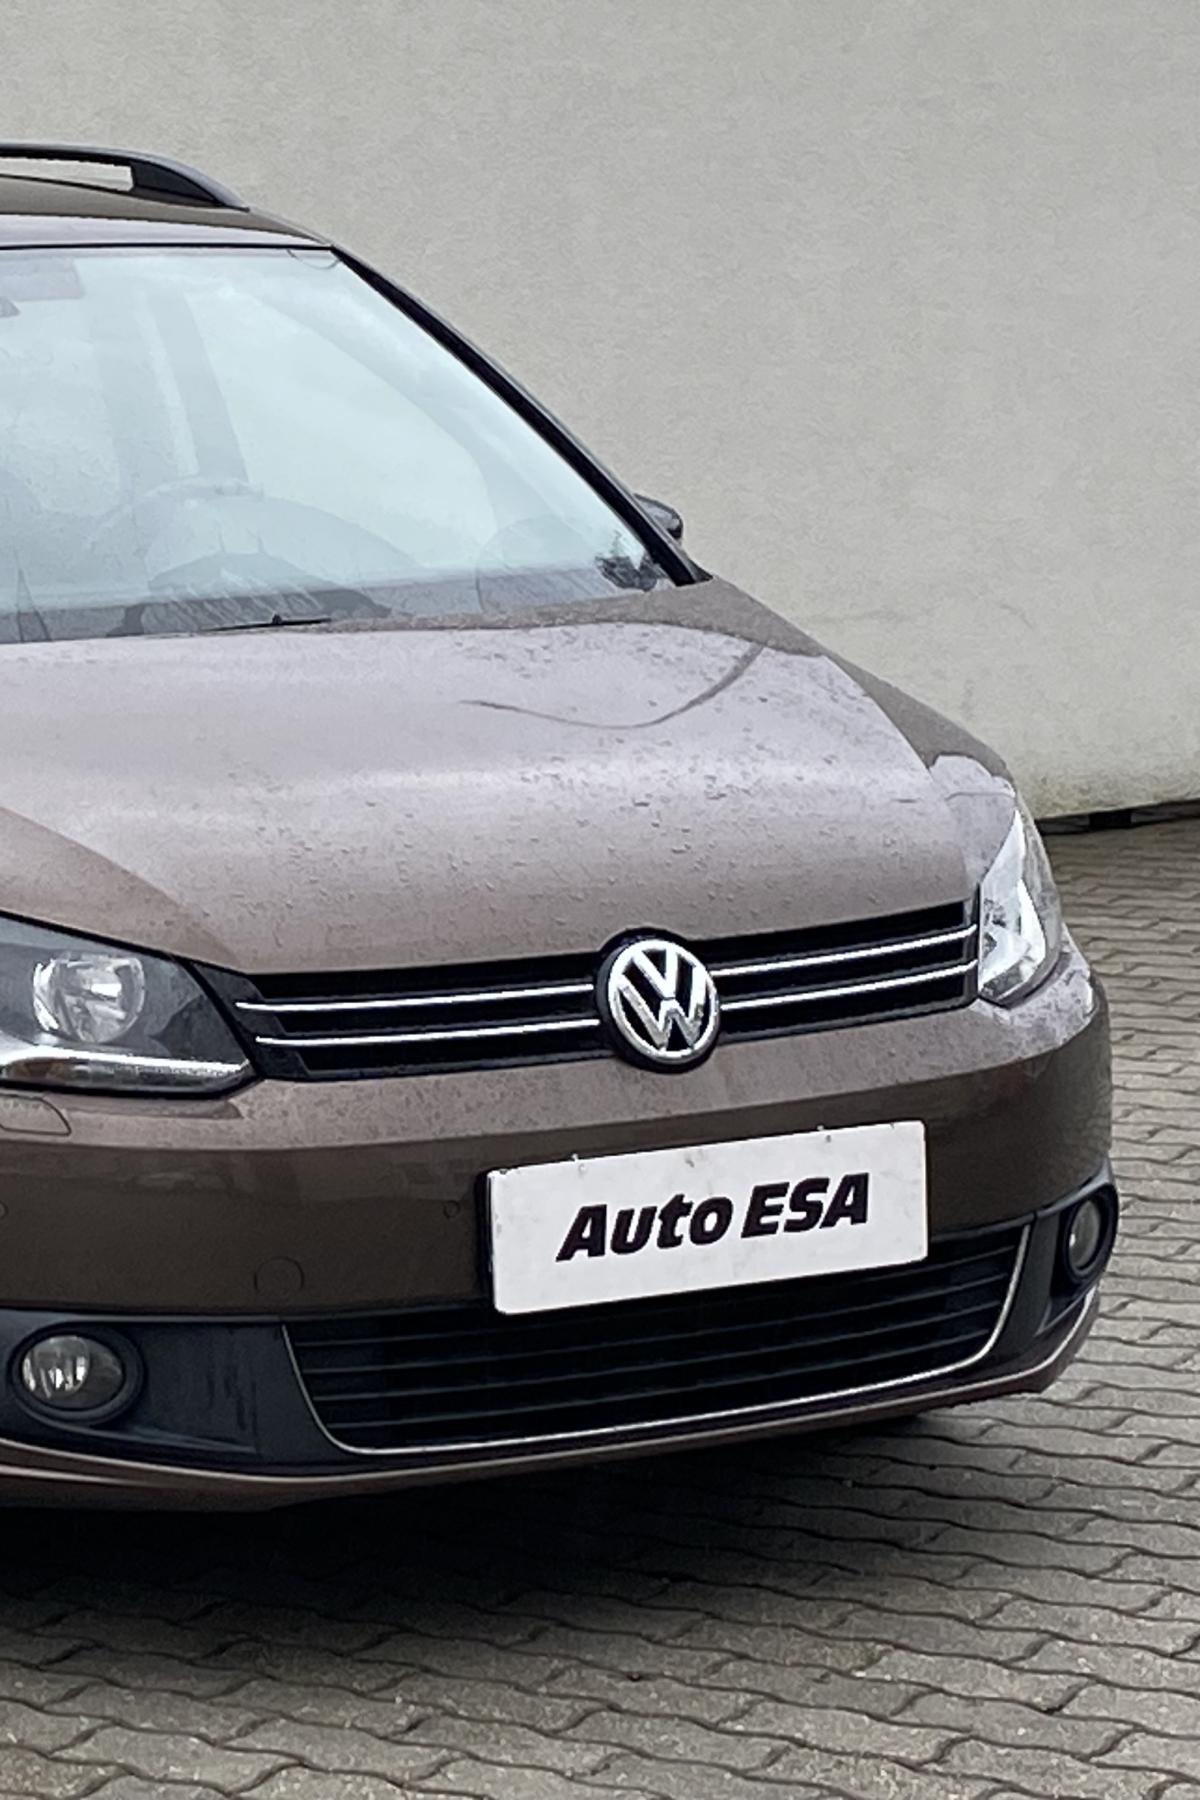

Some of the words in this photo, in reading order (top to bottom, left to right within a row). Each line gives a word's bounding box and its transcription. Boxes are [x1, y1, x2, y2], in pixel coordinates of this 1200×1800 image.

[613, 943, 710, 1055] VW
[555, 1194, 733, 1262] Auto
[740, 1172, 870, 1239] ESA
